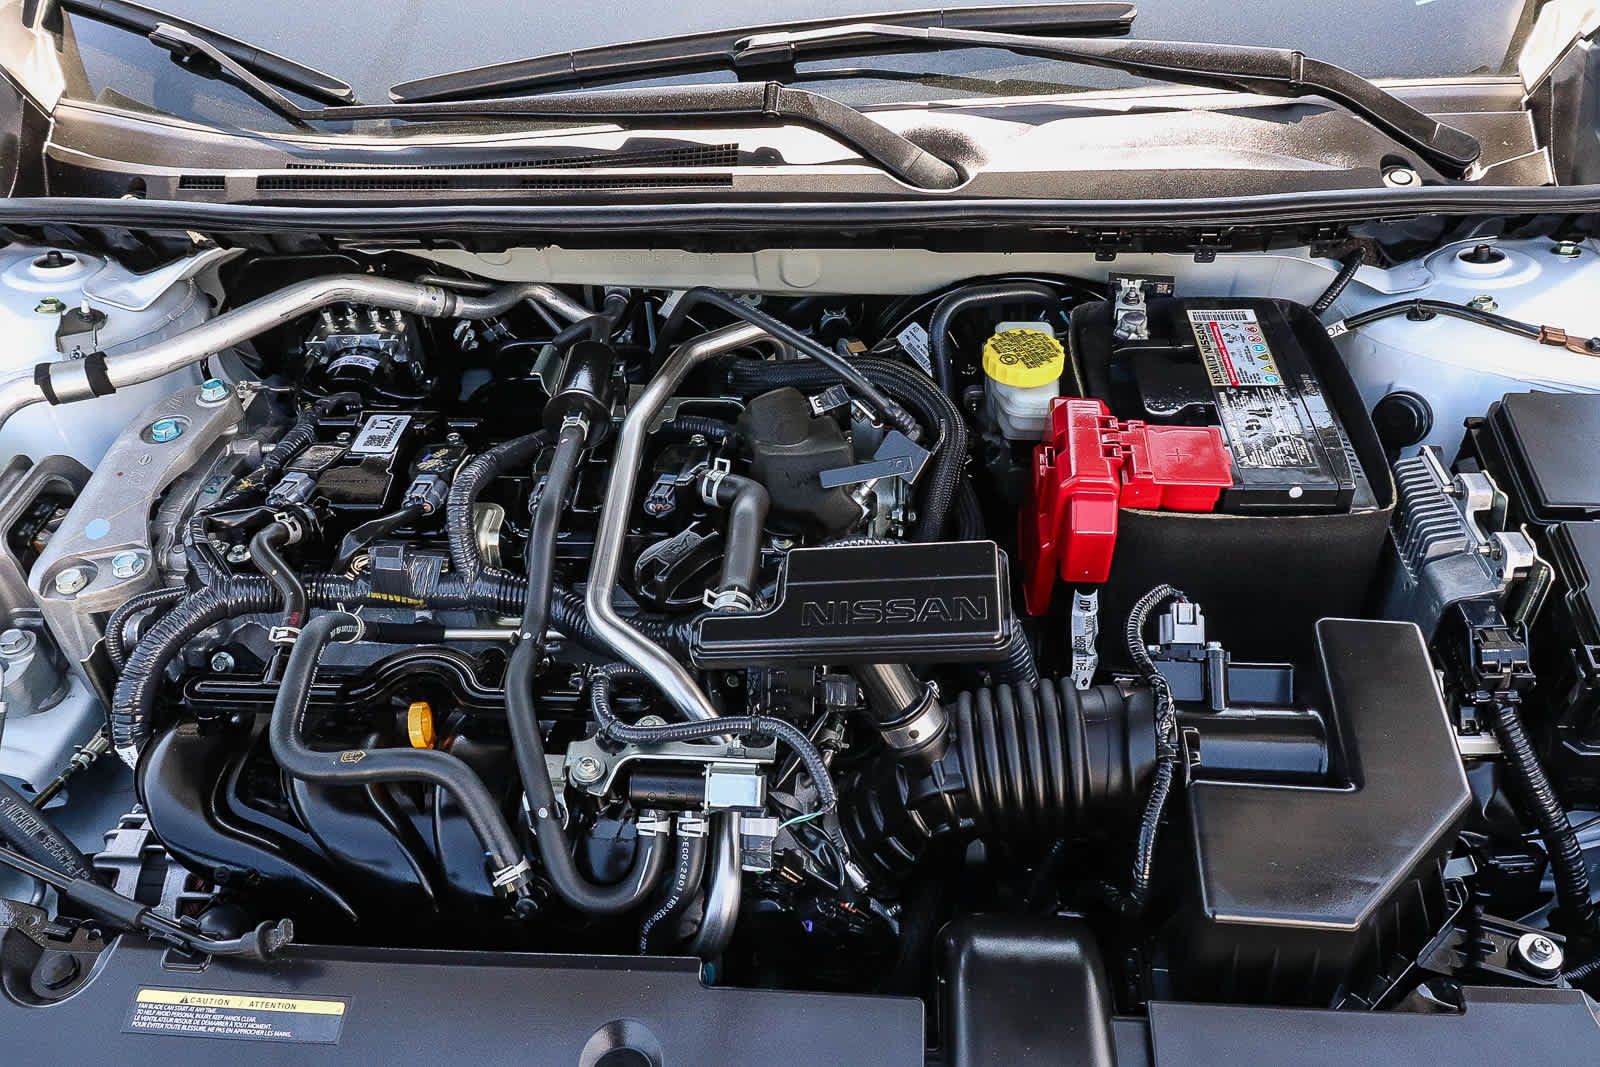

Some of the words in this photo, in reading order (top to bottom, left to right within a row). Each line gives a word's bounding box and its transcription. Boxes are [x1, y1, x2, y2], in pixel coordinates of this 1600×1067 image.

[1194, 323, 1212, 354] NISSAN
[1205, 355, 1224, 384] RENAULT
[801, 596, 988, 627] NISSAN
[190, 996, 229, 1006] CAUTION
[248, 1001, 297, 1010] ATTENTION
